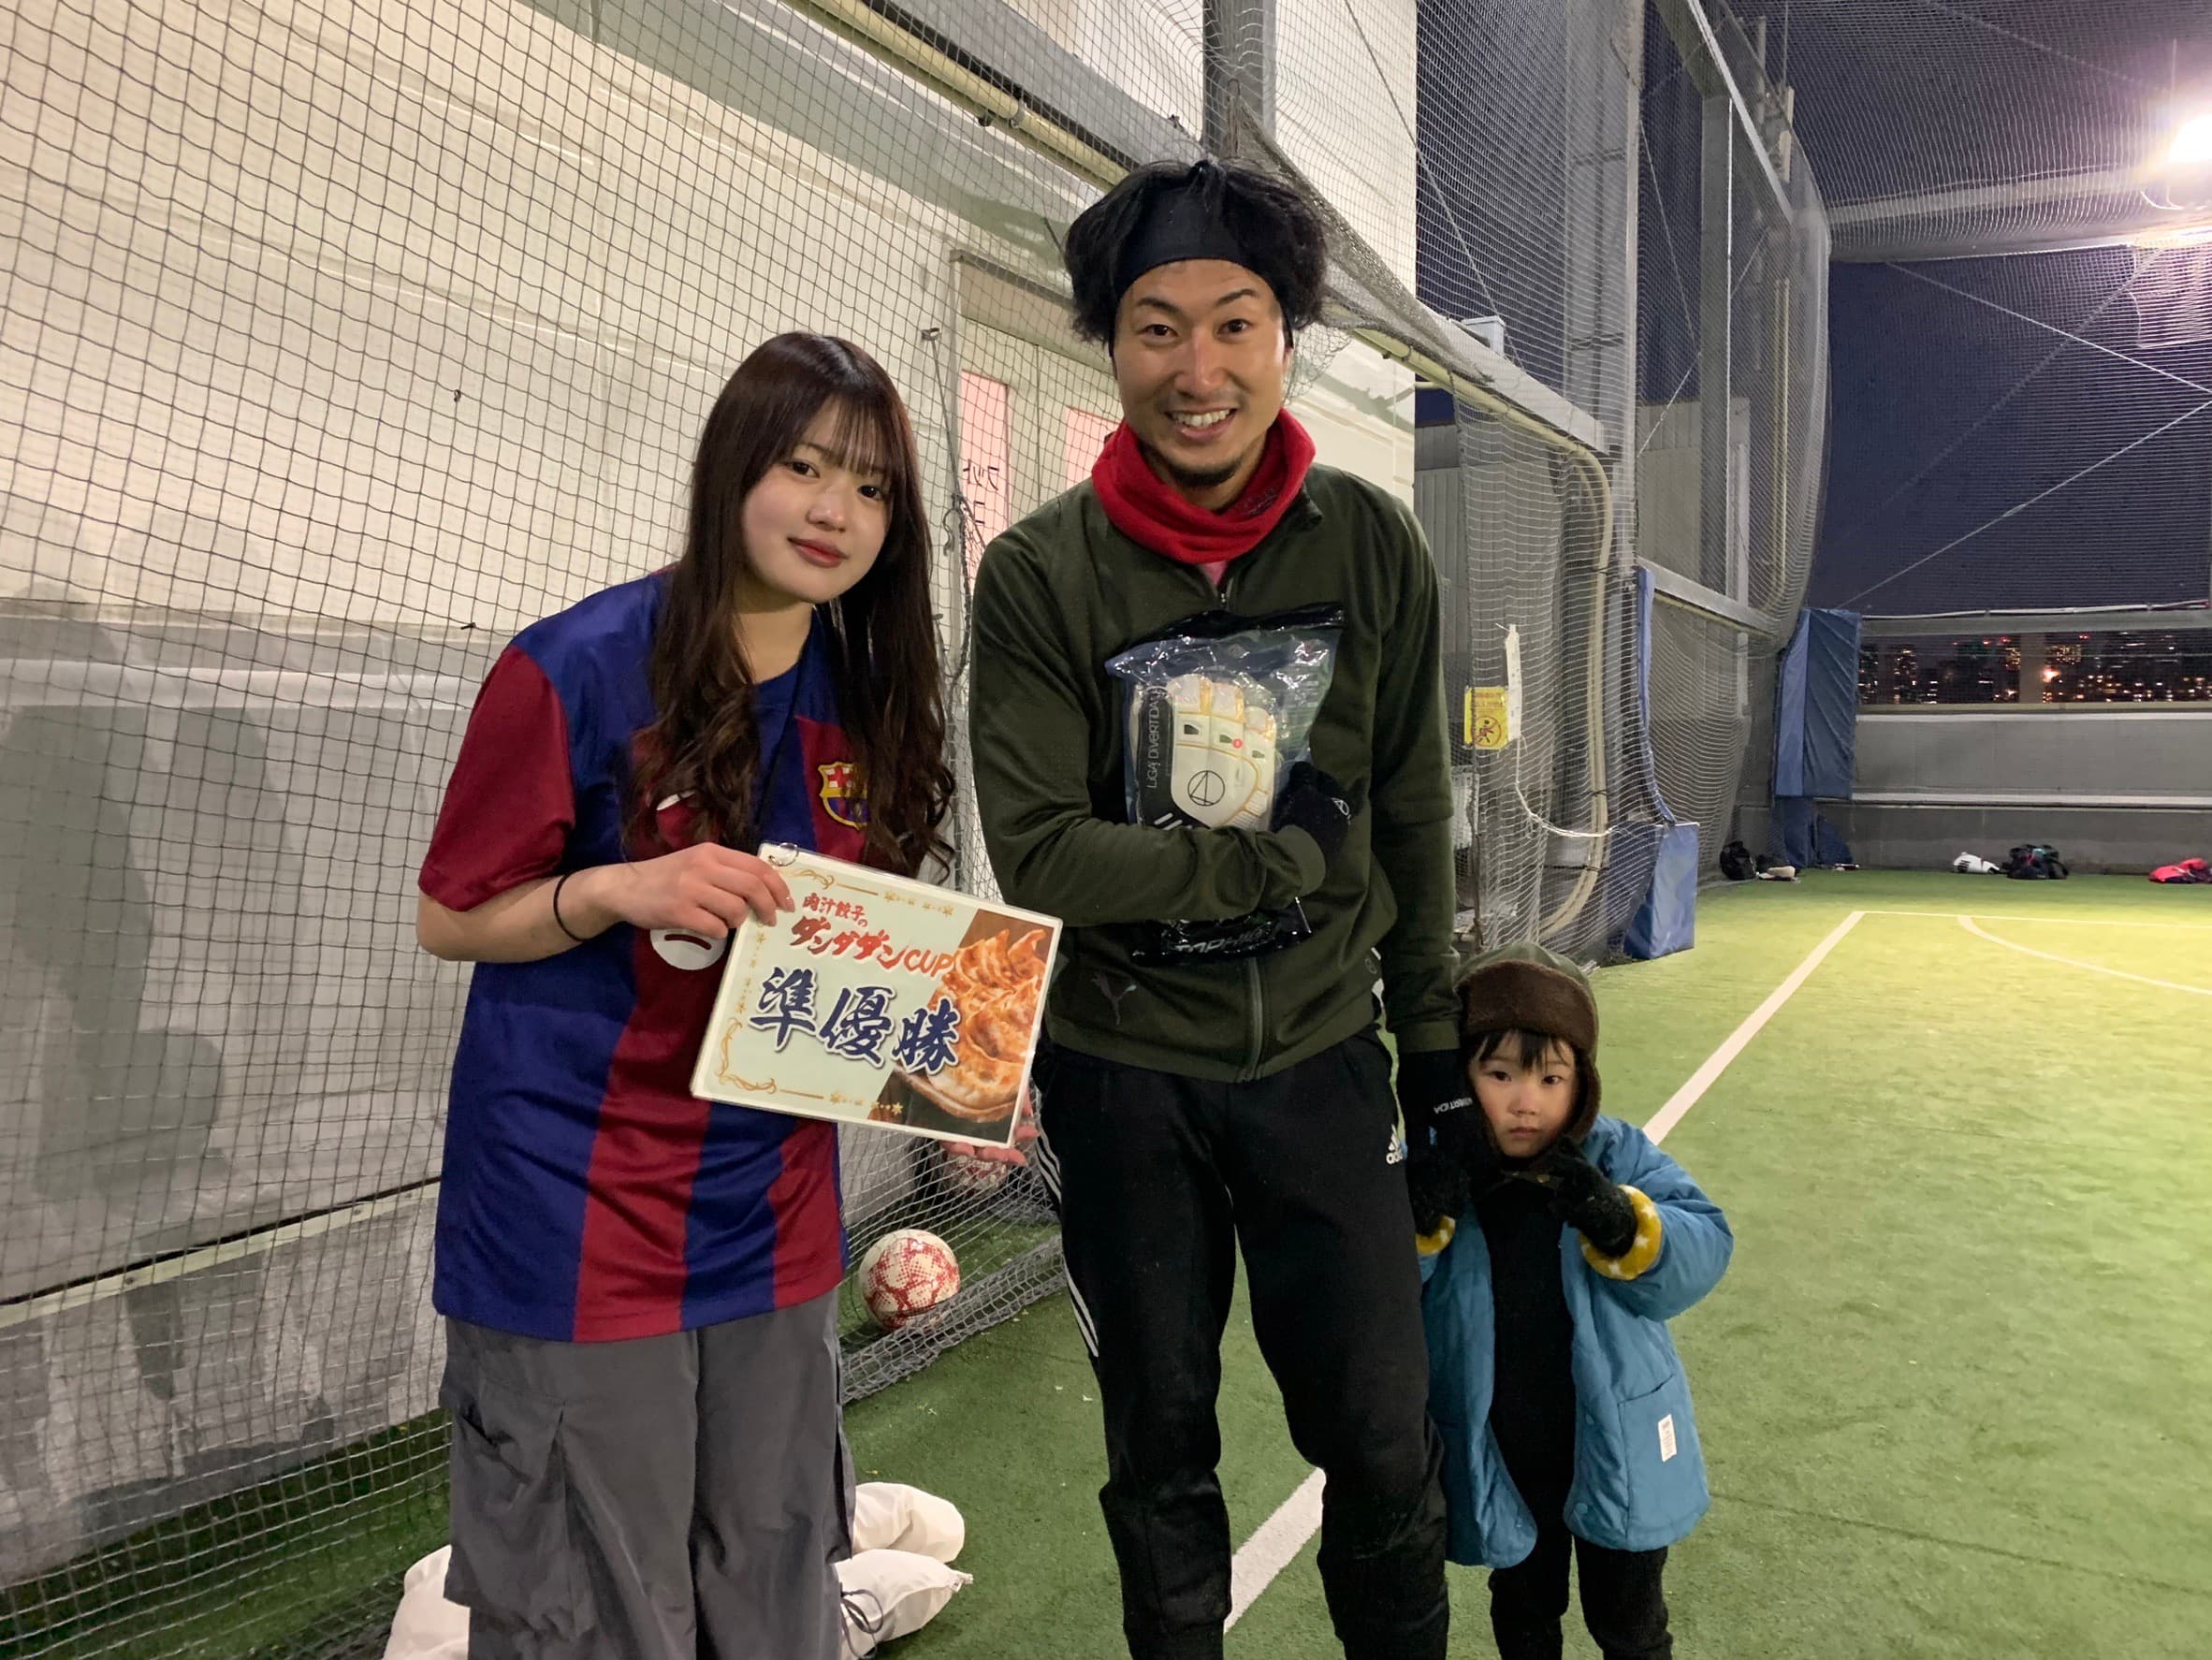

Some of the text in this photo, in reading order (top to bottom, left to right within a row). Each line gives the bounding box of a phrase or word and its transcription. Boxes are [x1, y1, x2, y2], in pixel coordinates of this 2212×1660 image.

[803, 893, 868, 927] 肉汁餃子の
[750, 967, 962, 1073] 準優勝
